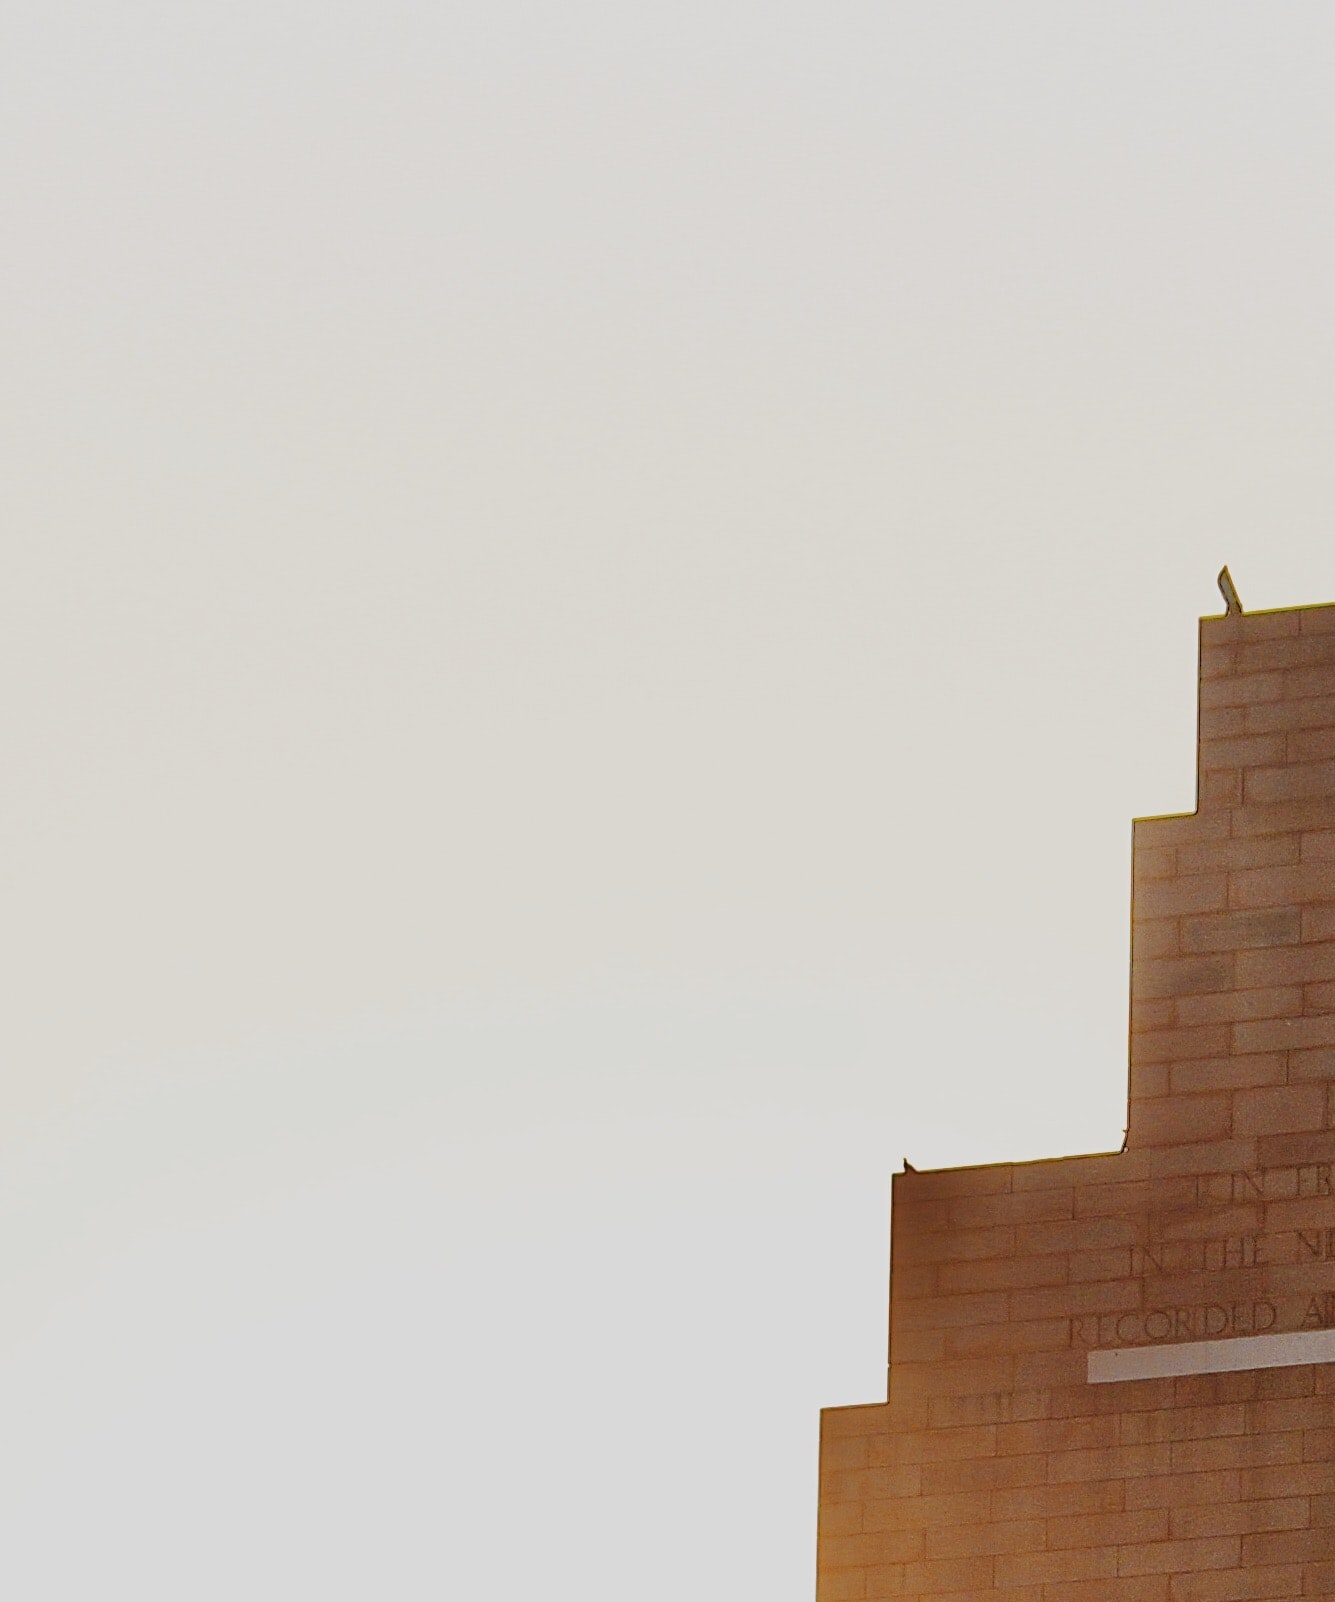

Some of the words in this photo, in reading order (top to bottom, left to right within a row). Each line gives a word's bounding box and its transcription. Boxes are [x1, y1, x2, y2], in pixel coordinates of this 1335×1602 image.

[1231, 1170, 1266, 1198] IN
[1130, 1247, 1167, 1280] IN
[1201, 1235, 1270, 1271] THE
[1068, 1300, 1277, 1349] RECORDED
